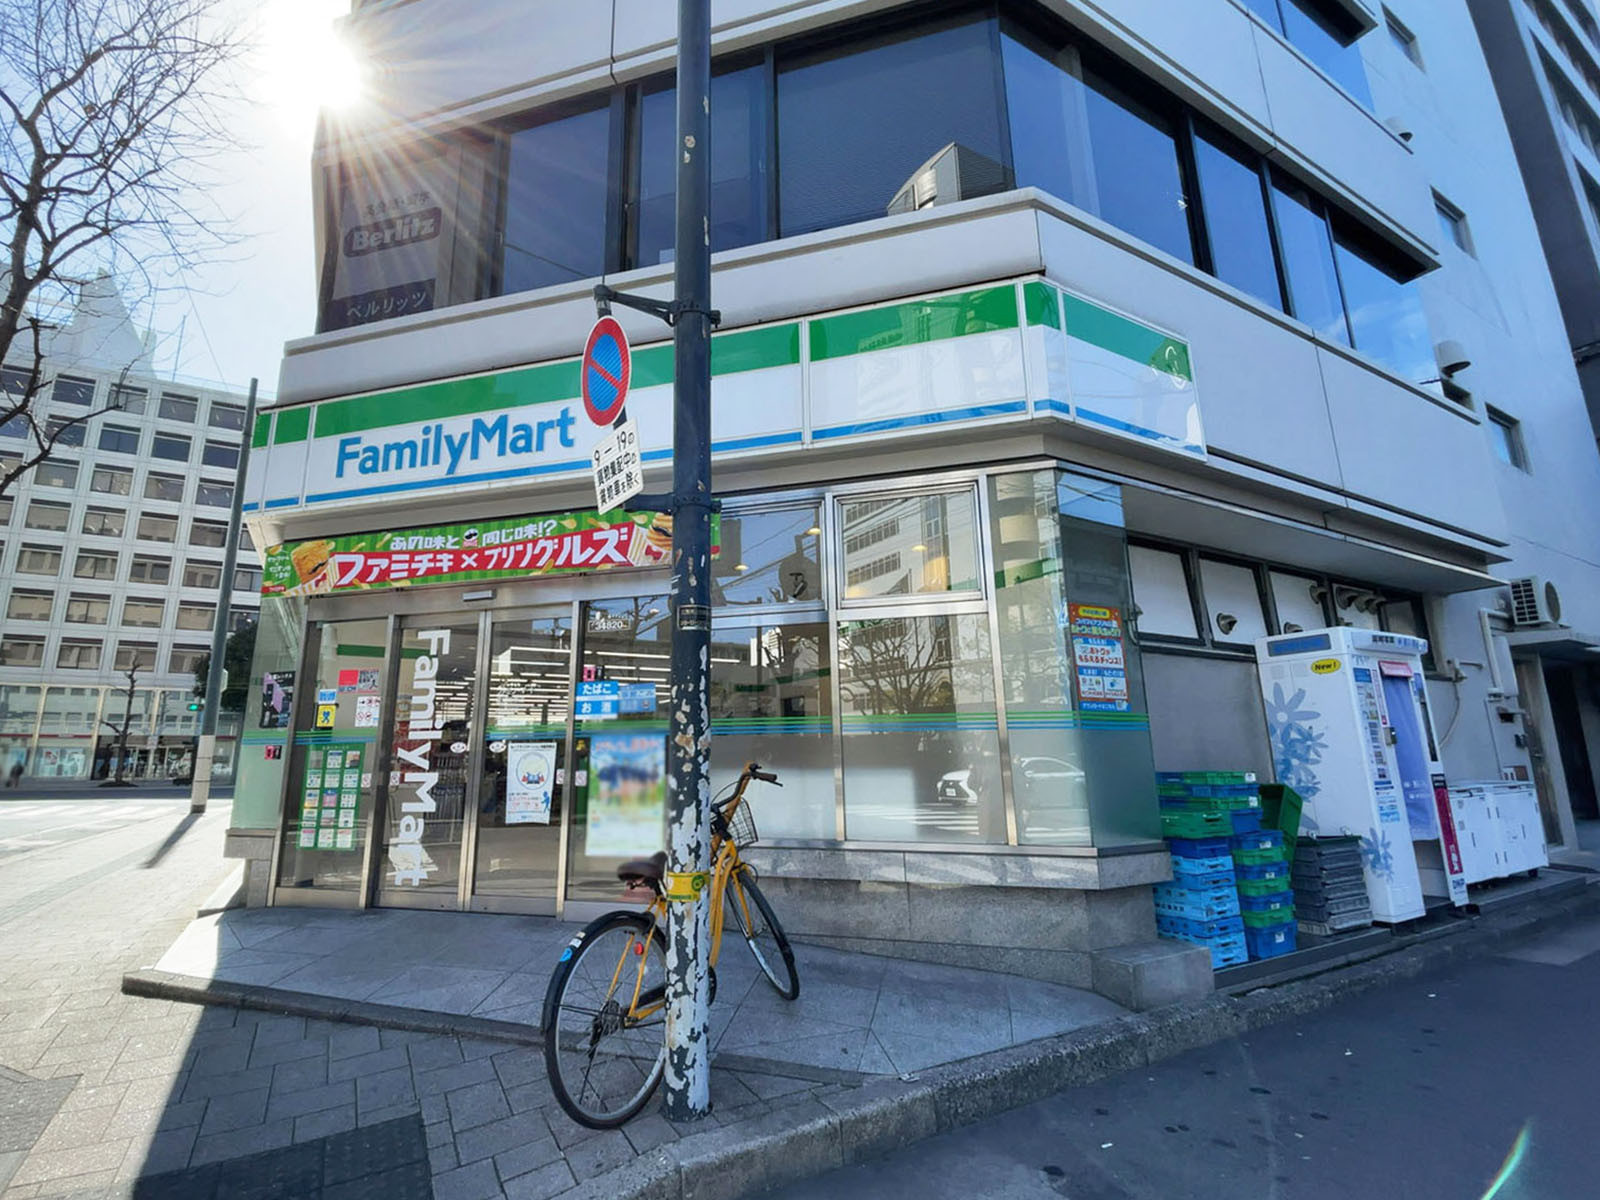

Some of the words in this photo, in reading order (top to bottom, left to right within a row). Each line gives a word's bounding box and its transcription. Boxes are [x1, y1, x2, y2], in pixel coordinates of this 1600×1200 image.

[351, 217, 435, 251] Berlitz
[346, 292, 426, 318] ベルリッツ
[335, 407, 576, 478] FamilyMart
[390, 534, 460, 550] あの味と
[582, 683, 612, 695] たばこ
[394, 629, 451, 887] FamilyMart
